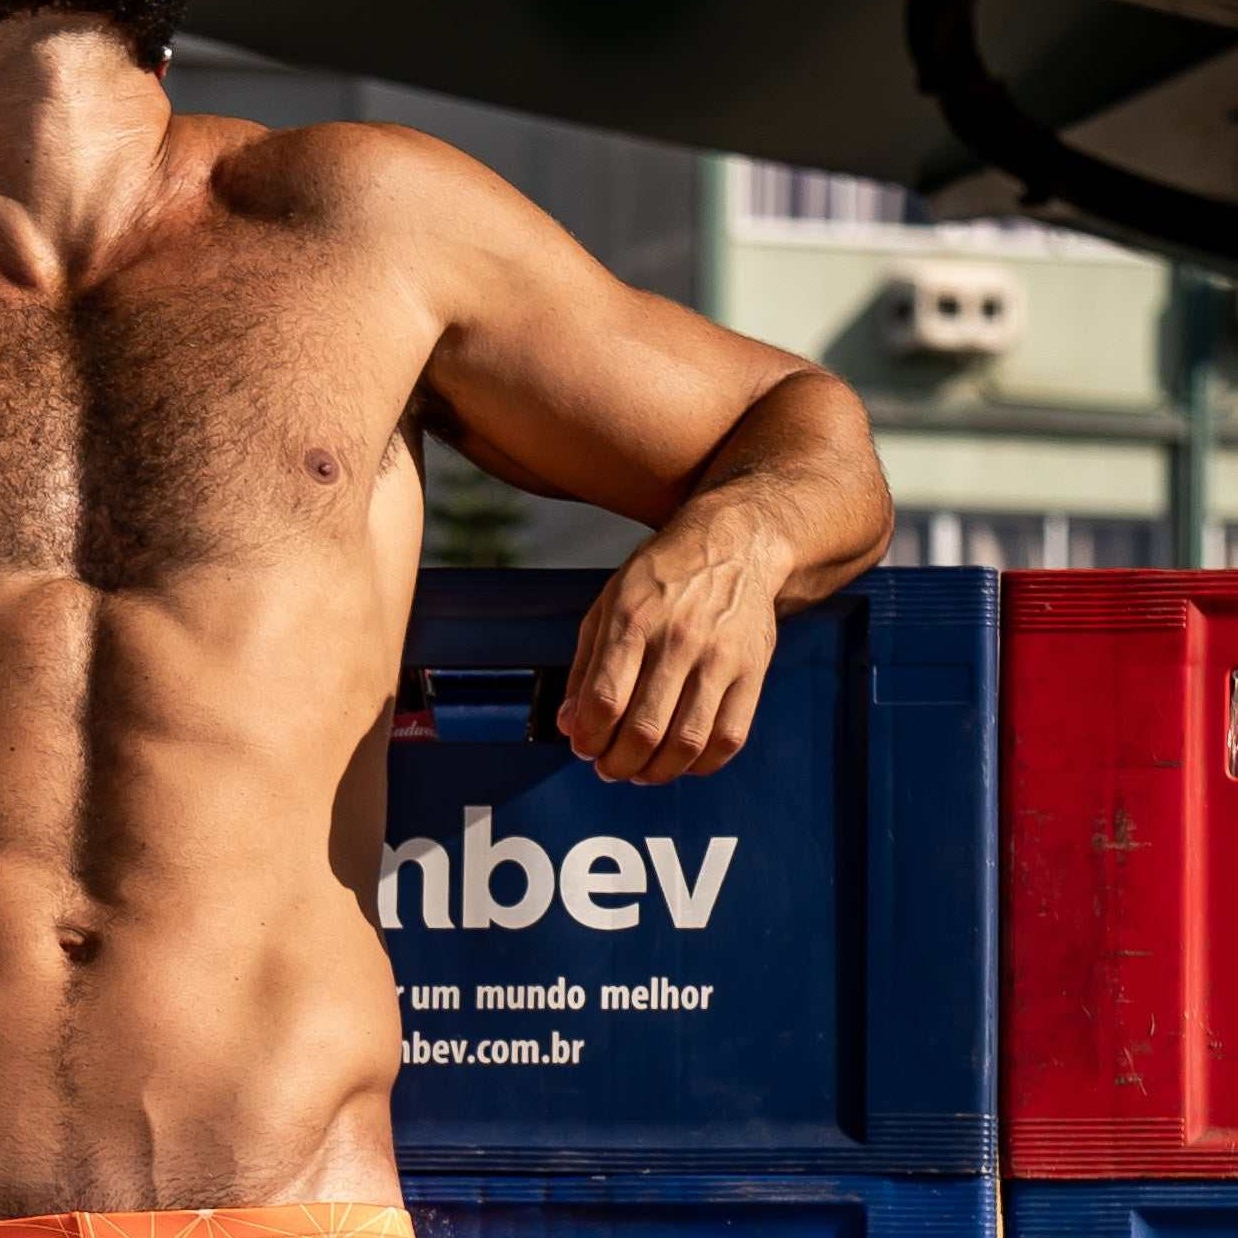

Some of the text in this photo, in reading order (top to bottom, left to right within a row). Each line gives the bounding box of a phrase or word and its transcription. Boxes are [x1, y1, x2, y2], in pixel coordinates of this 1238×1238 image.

[411, 984, 461, 1010] um
[476, 976, 586, 1010] mundo
[600, 977, 714, 1010] melhor
[402, 1031, 585, 1064] bev.com.br
